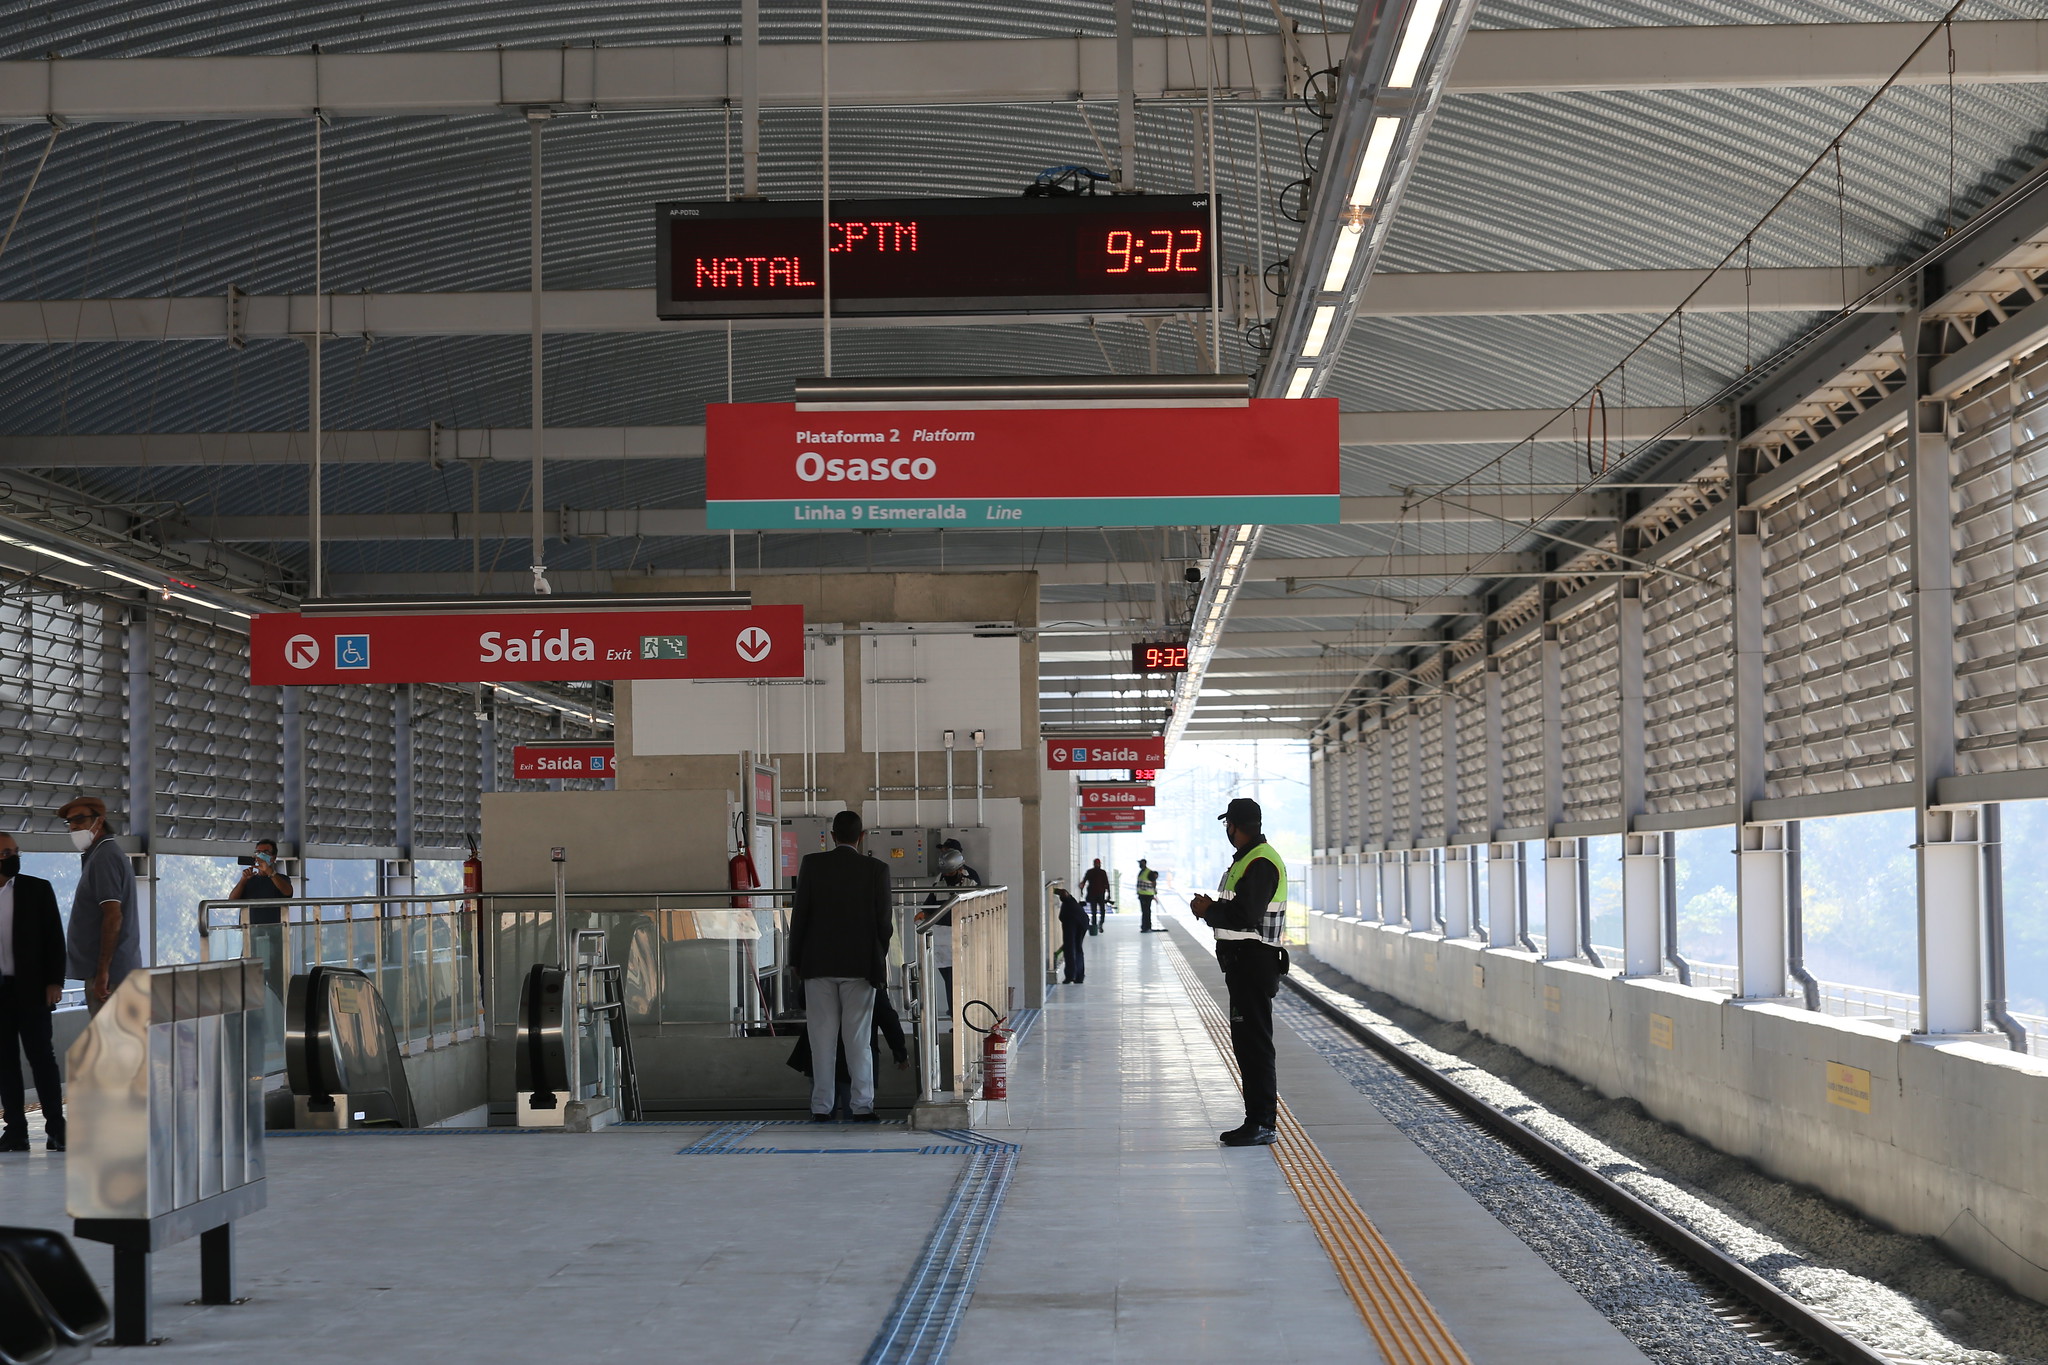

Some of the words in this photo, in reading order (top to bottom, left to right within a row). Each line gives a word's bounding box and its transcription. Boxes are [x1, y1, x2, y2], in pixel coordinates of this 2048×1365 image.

[1106, 229, 1203, 273] 9:32
[696, 256, 816, 288] NATAL
[796, 430, 885, 443] Plataforma
[889, 428, 901, 443] 2
[912, 428, 976, 442] Platform
[795, 451, 937, 482] Osasco
[794, 505, 846, 521] Linha
[851, 505, 864, 521] 9
[868, 504, 967, 520] Esmeralda
[986, 504, 1023, 520] Line
[479, 628, 595, 663] Saída
[606, 648, 633, 661] Exit
[1146, 648, 1187, 668] 9:32
[1091, 747, 1138, 761] Saída
[1145, 753, 1160, 761] Exit
[519, 763, 534, 771] Exit
[537, 756, 582, 770] Saída
[1135, 769, 1155, 779] 9:32
[1101, 792, 1136, 802] Saída
